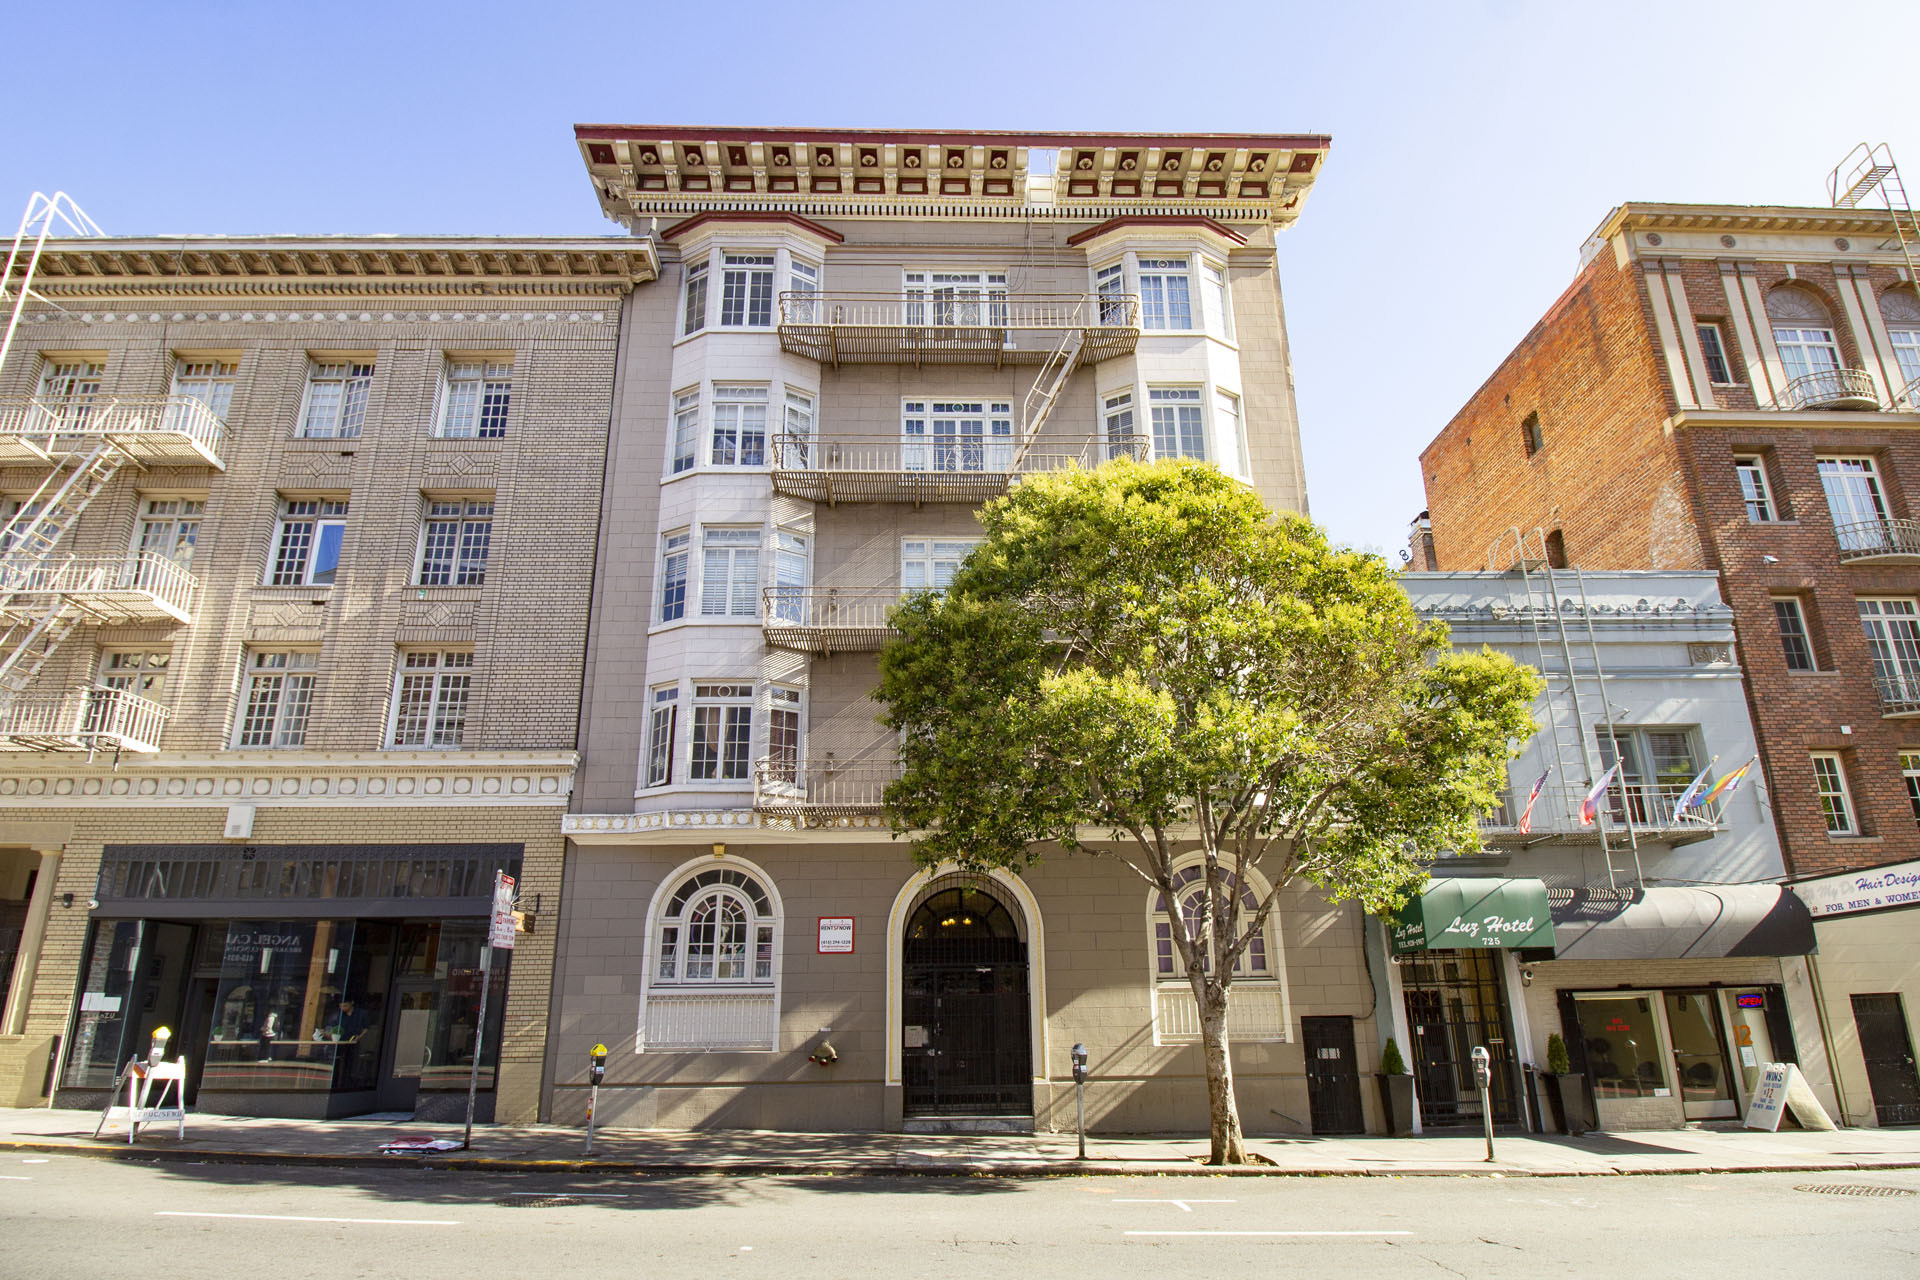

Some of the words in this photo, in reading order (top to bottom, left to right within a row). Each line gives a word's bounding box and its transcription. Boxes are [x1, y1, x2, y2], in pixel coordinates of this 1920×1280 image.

[1855, 878, 1884, 892] Hair
[1825, 903, 1844, 912] FOR
[1848, 899, 1870, 909] MEN
[1875, 897, 1882, 905] &
[1406, 921, 1424, 936] Hotel
[1445, 916, 1479, 938] Luz
[1483, 915, 1535, 933] Hotel
[1481, 937, 1501, 945] 725
[1738, 997, 1763, 1006] OPEN
[1733, 1024, 1753, 1046] 12
[1765, 1071, 1784, 1082] WINS
